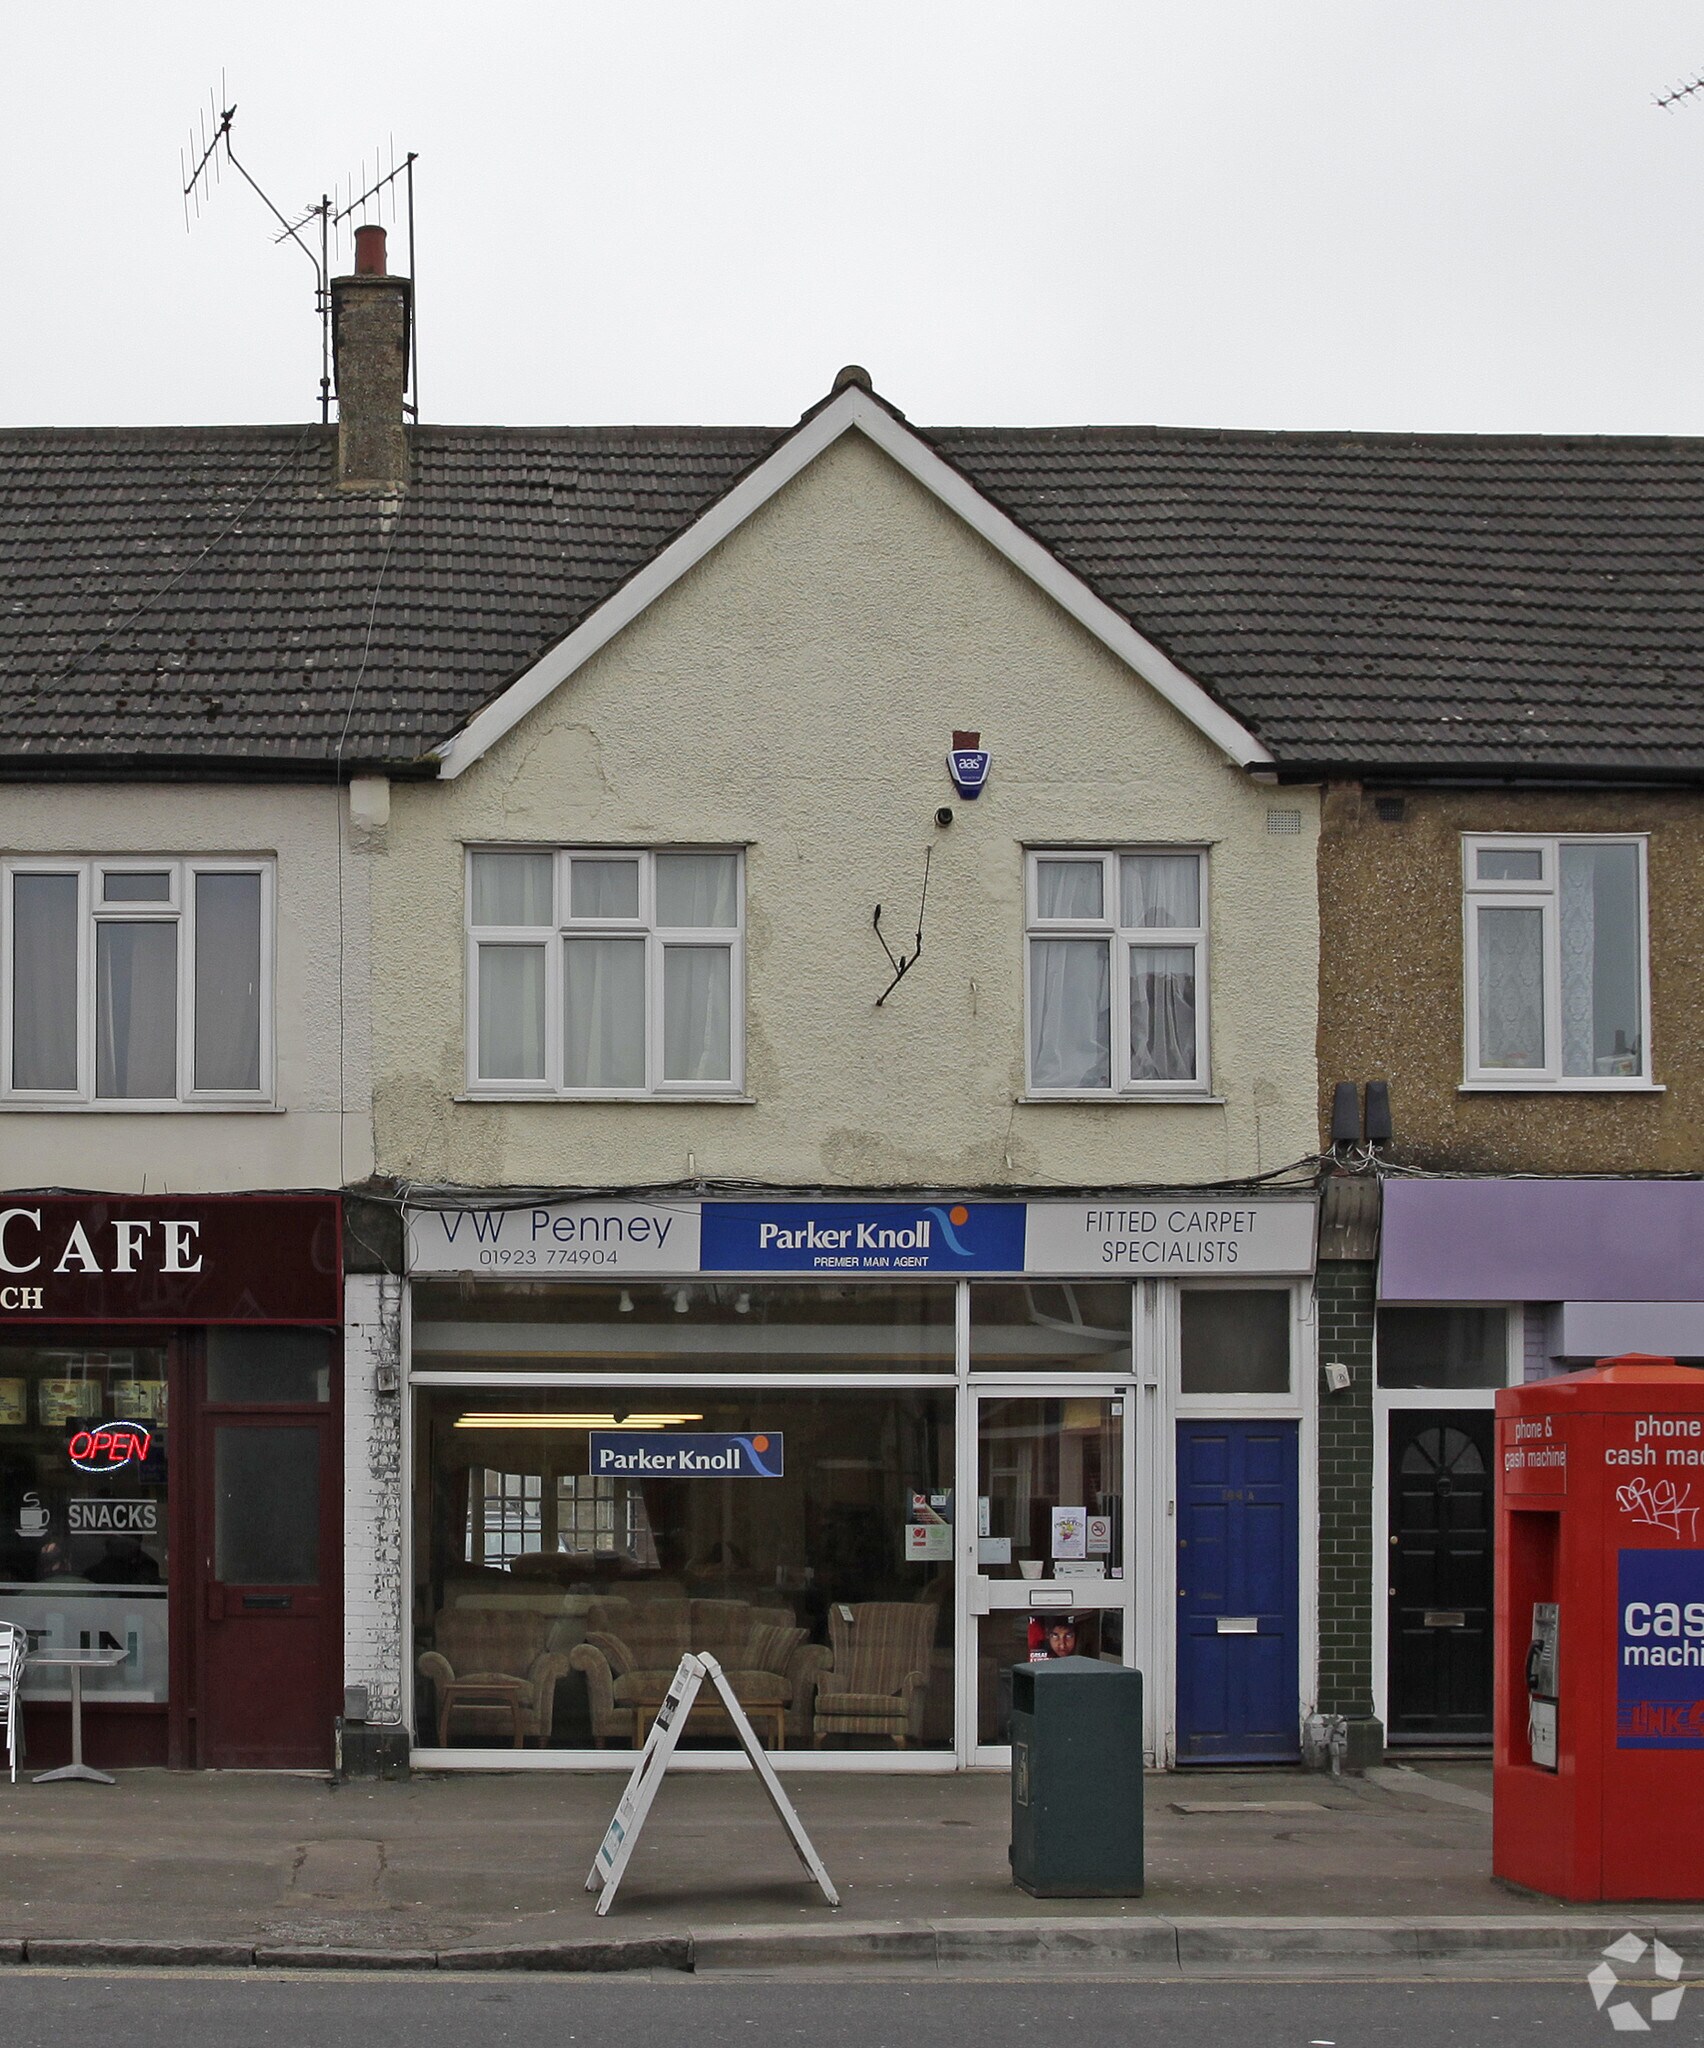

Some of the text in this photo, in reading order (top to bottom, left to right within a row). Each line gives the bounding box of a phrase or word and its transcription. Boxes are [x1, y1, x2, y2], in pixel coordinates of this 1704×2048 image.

[531, 1210, 673, 1249] Penney
[1085, 1211, 1258, 1233] FITTED CARPET
[0, 1208, 203, 1274] CAFE
[759, 1220, 931, 1249] Parker Knoll
[479, 1249, 618, 1265] 01923 774904
[814, 1256, 930, 1267] PREMIER MAIN AGENT
[1101, 1241, 1239, 1263] SPECIALISTS
[0, 1287, 44, 1310] CH
[1515, 1415, 1553, 1444] phone &
[1634, 1414, 1701, 1442] phone
[68, 1431, 152, 1461] OPEN
[1504, 1445, 1567, 1468] cash machine
[1604, 1443, 1704, 1466] cash ma
[600, 1448, 741, 1470] Parker Knoll
[68, 1504, 157, 1528] SNACKS
[1624, 1602, 1704, 1637] cas
